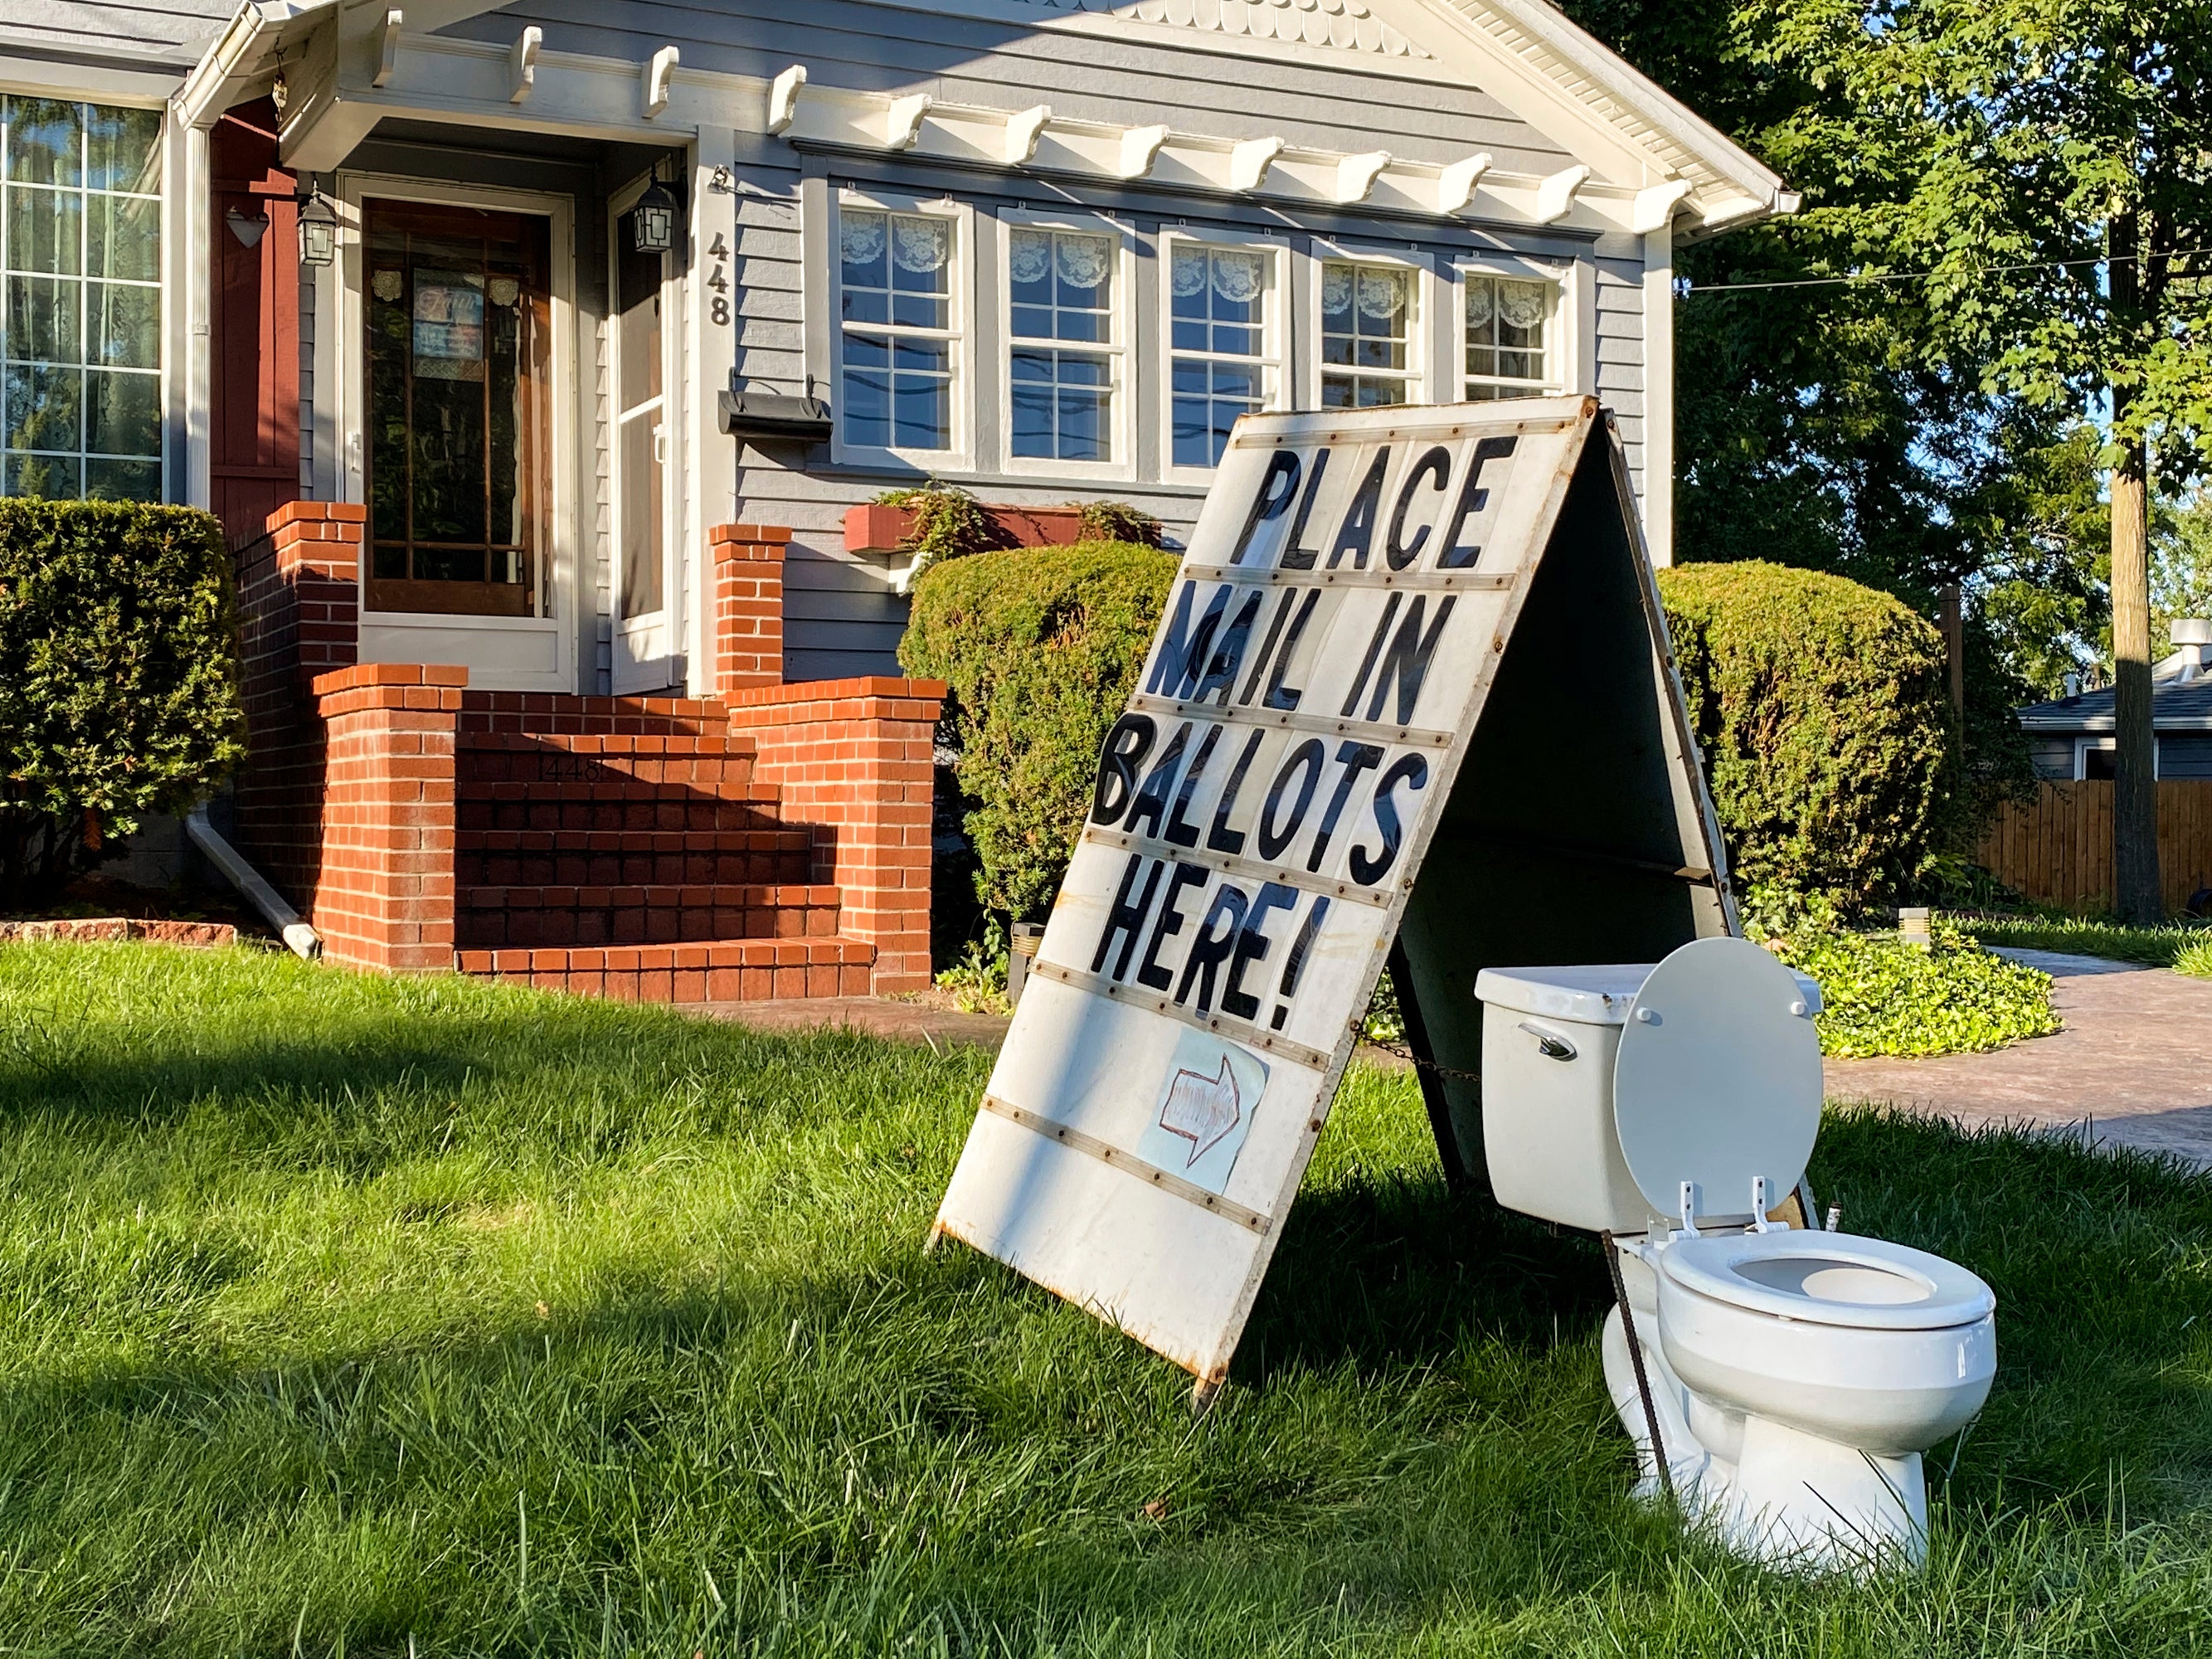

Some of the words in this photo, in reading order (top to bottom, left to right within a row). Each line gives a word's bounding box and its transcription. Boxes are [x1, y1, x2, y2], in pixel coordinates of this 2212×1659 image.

[707, 232, 730, 326] 448
[1230, 435, 1519, 570] PLACE
[1145, 581, 1321, 709] MAIL
[1341, 591, 1457, 725] IN
[546, 757, 599, 781] 448
[1091, 713, 1428, 886] BALLOTS
[1091, 854, 1330, 1030] HERE!
